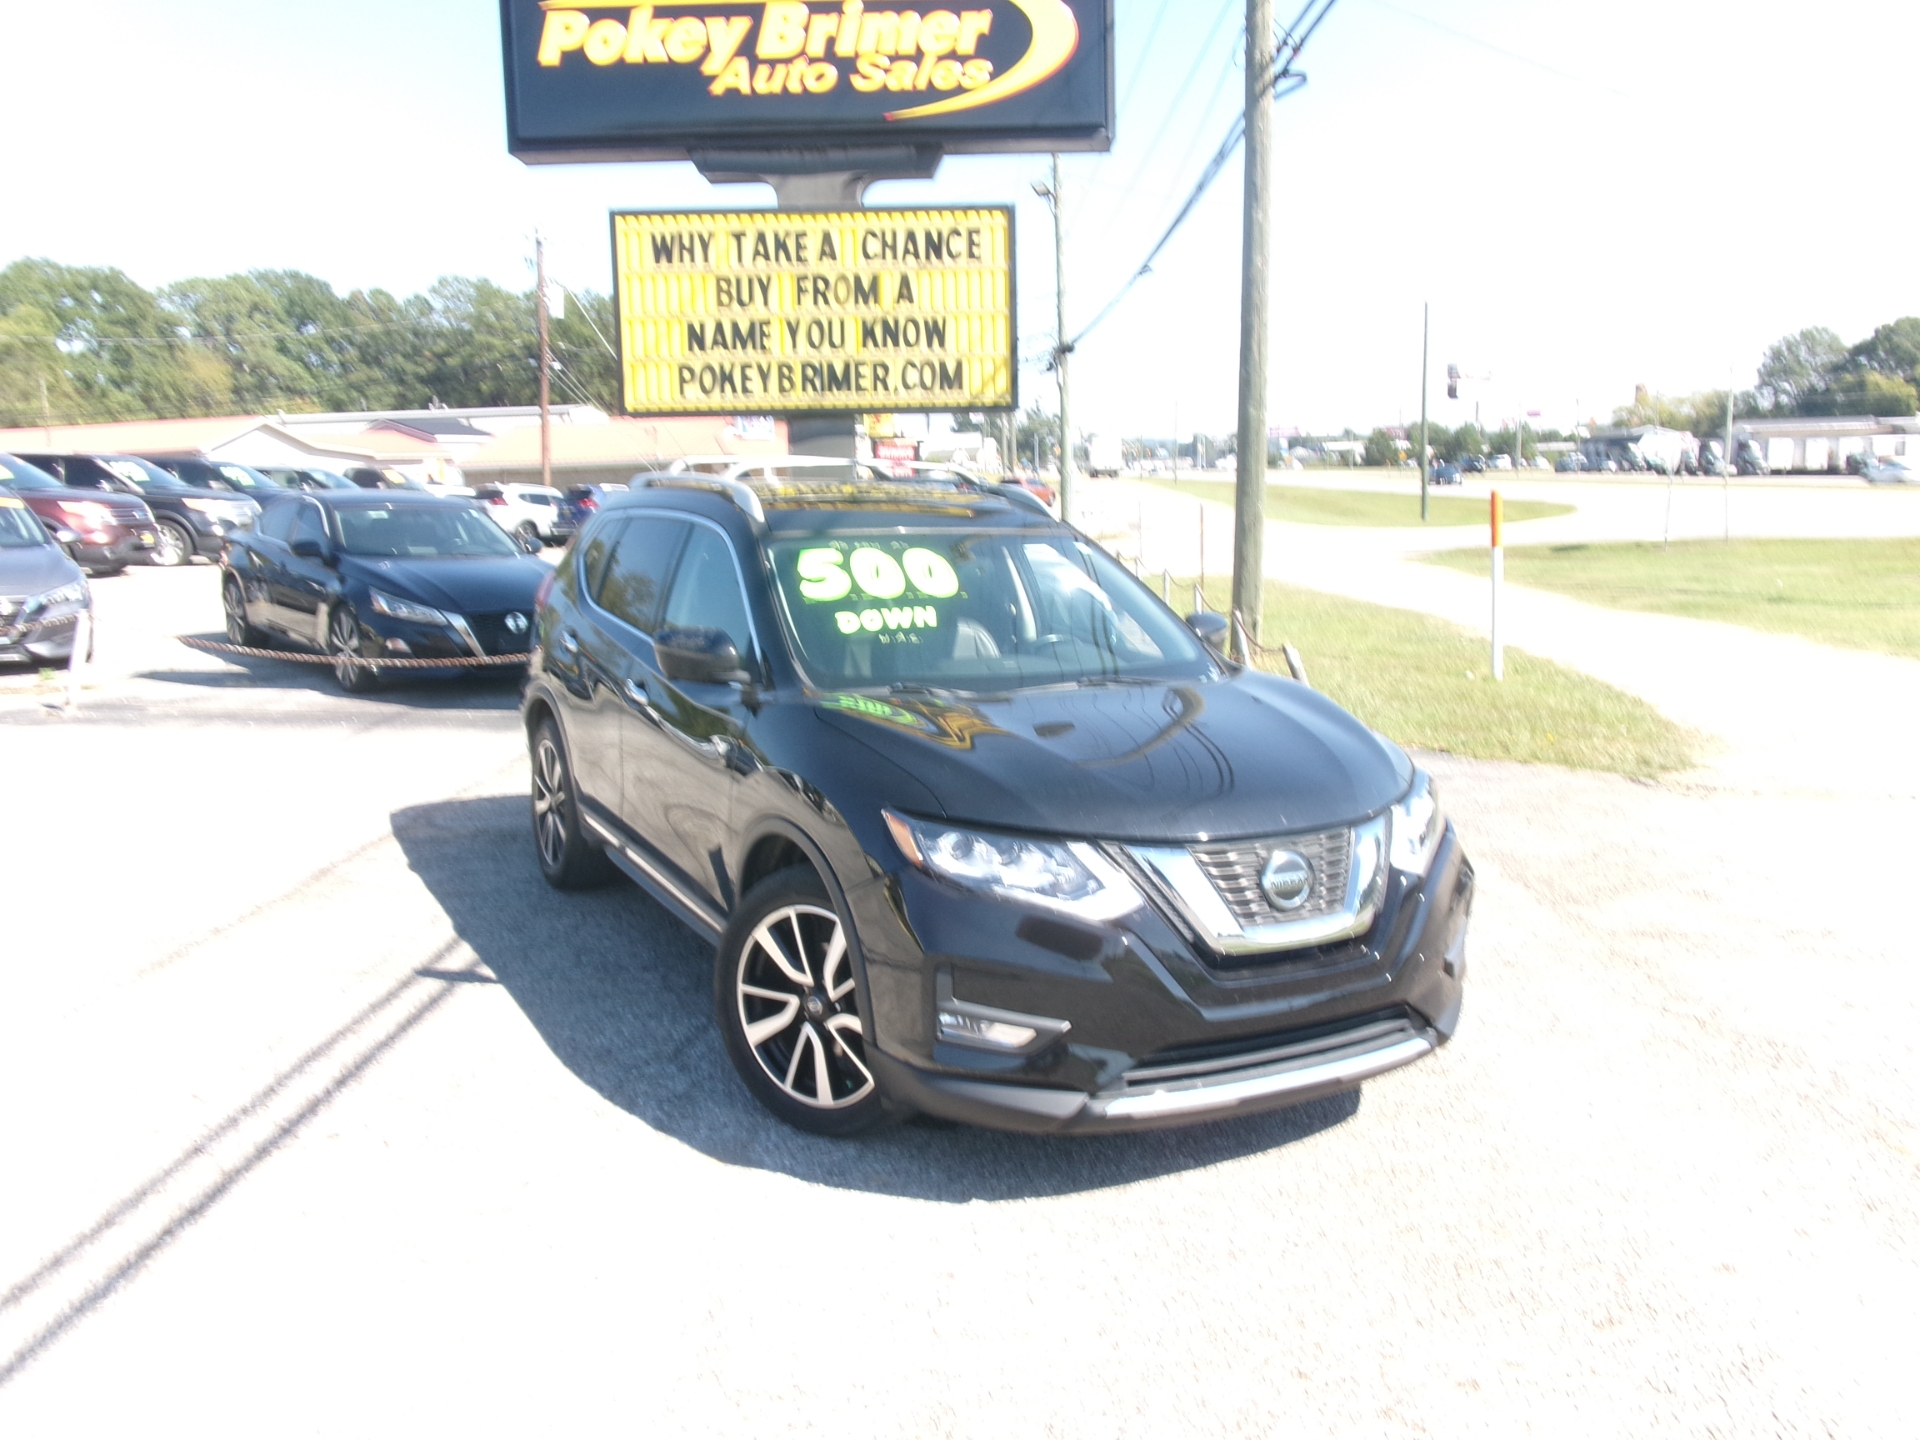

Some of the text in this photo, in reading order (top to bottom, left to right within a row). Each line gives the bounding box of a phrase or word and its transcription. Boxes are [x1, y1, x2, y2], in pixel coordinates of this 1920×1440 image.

[537, 0, 994, 76] Pokey Brimer
[707, 53, 994, 97] Auto Sales
[651, 228, 982, 264] WHY TAKE A CHANCE
[716, 272, 915, 307] BUY FROM A
[687, 316, 947, 351] NAME YOU KNOW
[678, 361, 964, 395] POKEYBRIMER.COM
[797, 547, 960, 601] 500
[834, 605, 937, 634] DOWN
